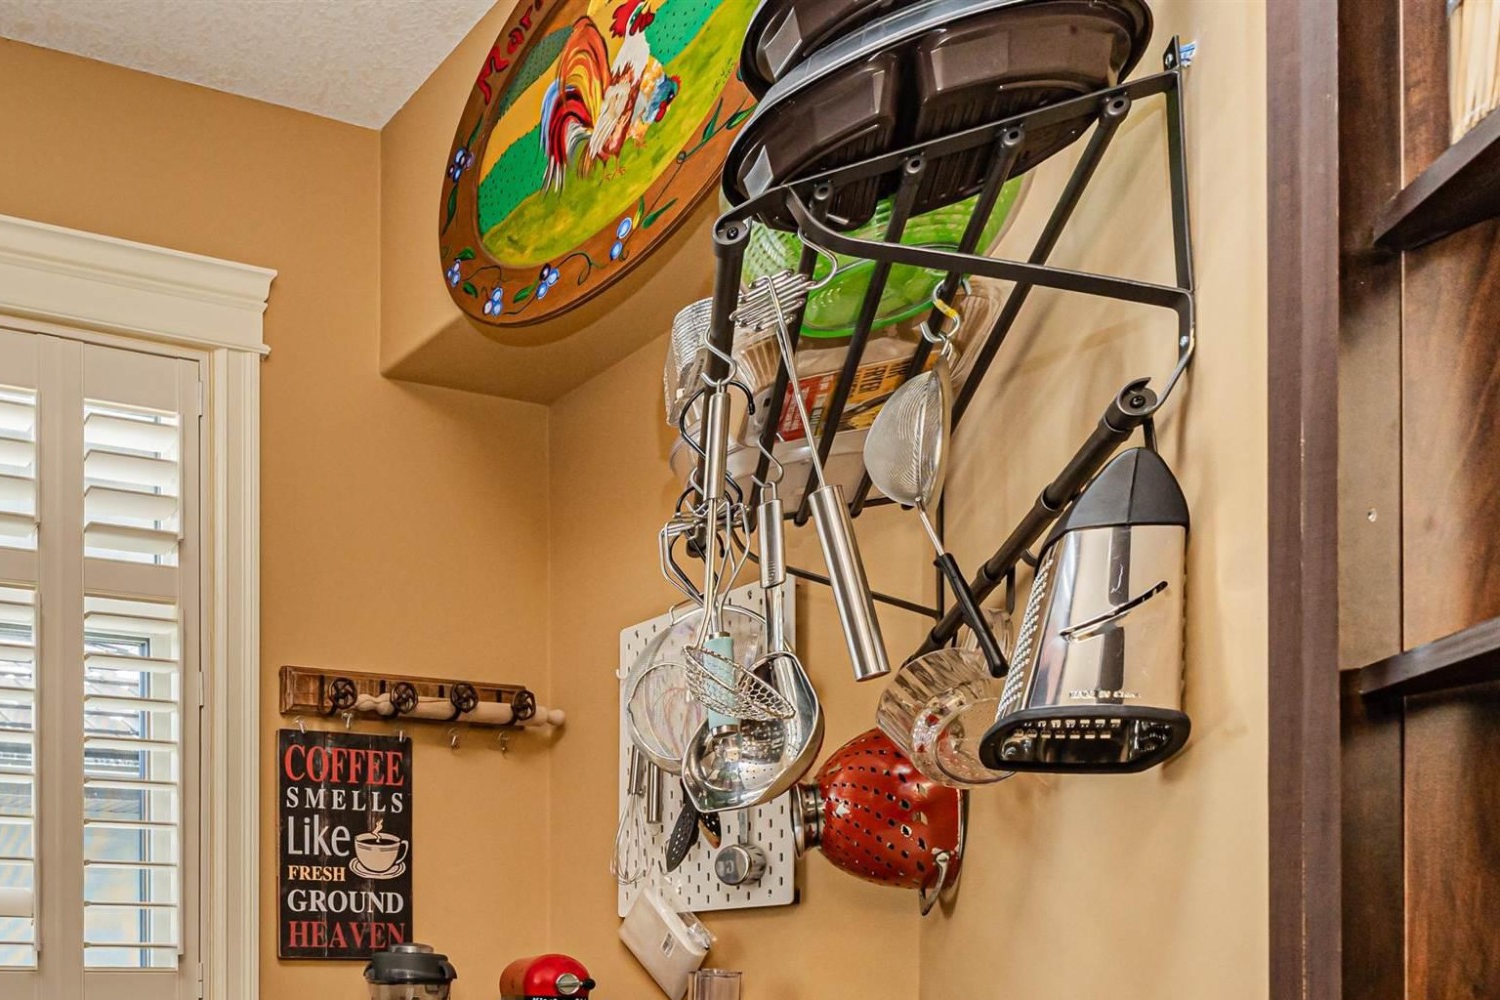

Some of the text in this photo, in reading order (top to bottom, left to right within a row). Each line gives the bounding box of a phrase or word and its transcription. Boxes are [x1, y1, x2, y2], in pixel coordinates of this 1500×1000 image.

[284, 744, 404, 786] COFFEE
[286, 786, 404, 814] SMELLS
[288, 814, 351, 857] Like
[288, 865, 346, 882] FRESH
[287, 889, 404, 914] GROUND
[289, 921, 405, 949] HEAVEN
